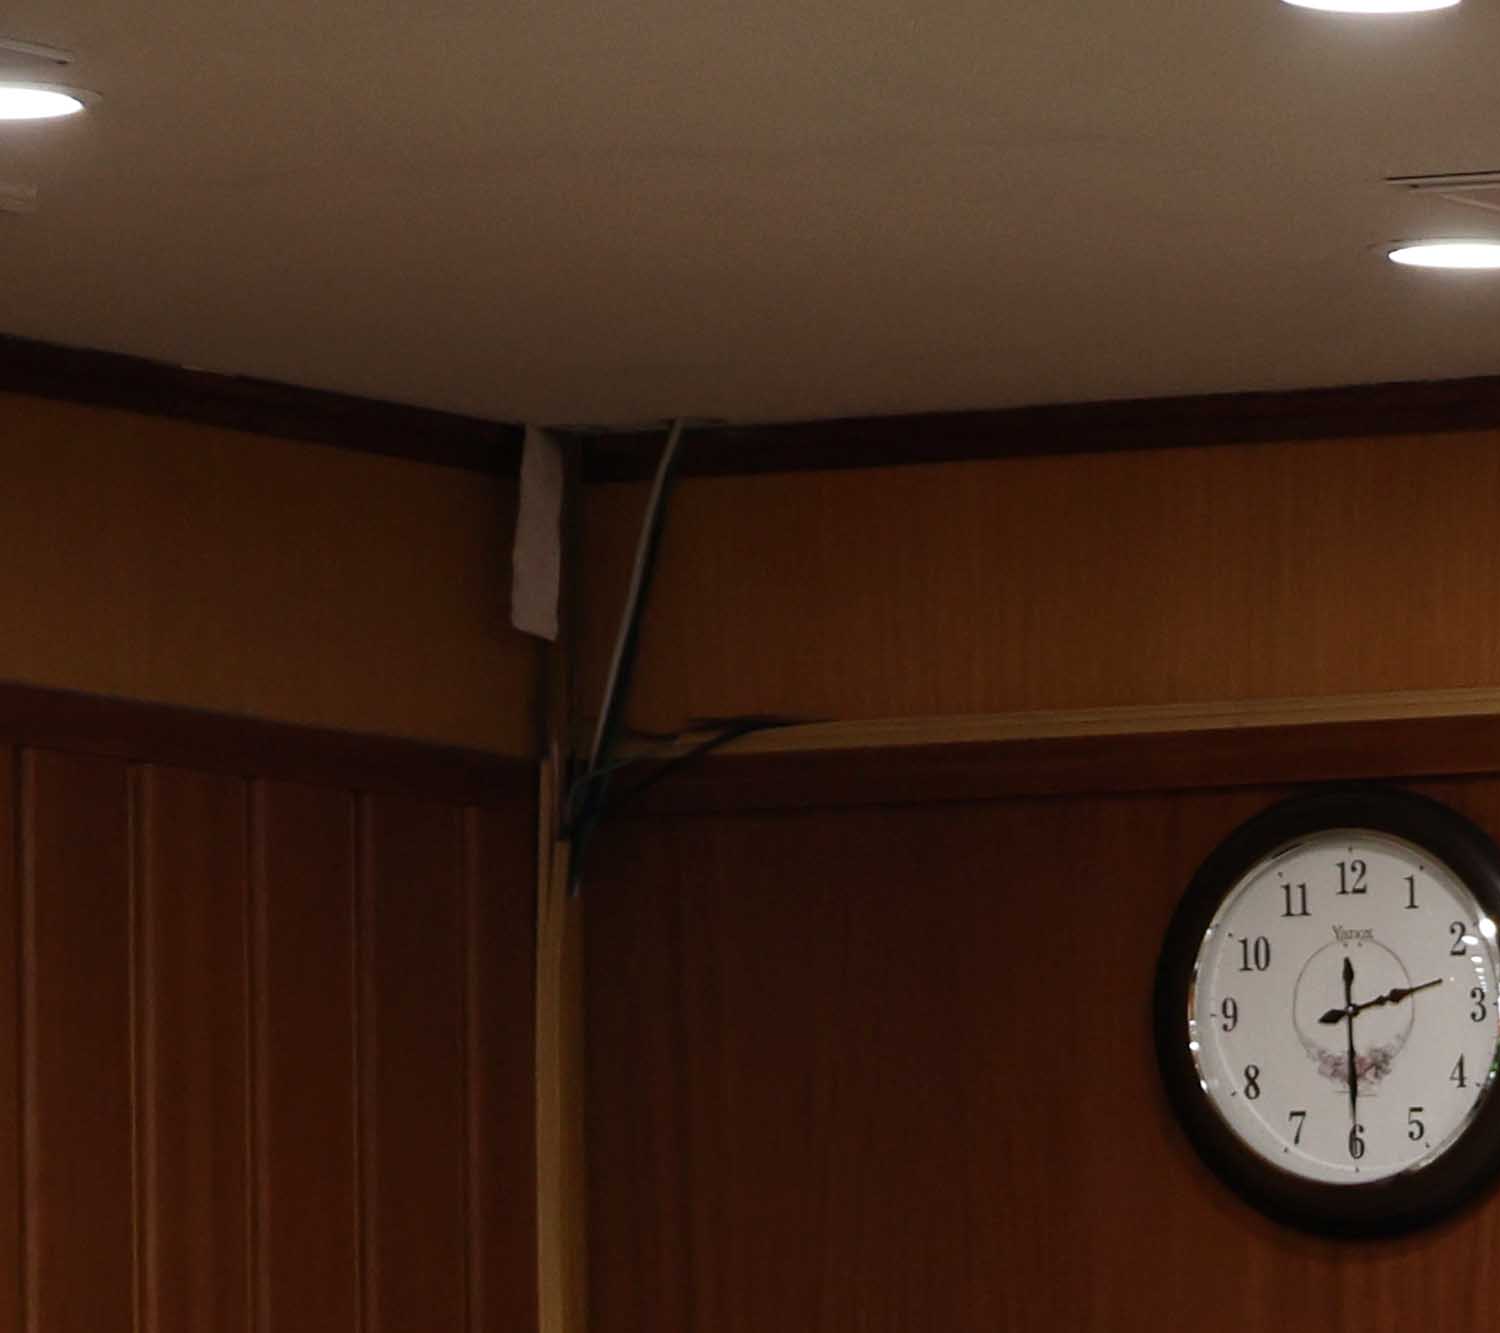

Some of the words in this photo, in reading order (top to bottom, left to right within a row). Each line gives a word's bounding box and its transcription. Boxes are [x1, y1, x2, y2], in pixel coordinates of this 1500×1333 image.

[1335, 859, 1368, 896] 12
[1403, 874, 1419, 910] 1
[1279, 882, 1313, 918] 11
[1238, 935, 1271, 972] 10
[1449, 921, 1468, 957] 2
[1221, 996, 1239, 1033] 9
[1470, 987, 1487, 1023] 3
[1243, 1064, 1261, 1101] 8
[1449, 1054, 1466, 1089] 4
[1288, 1110, 1307, 1145] 7
[1347, 1122, 1366, 1160] 6
[1407, 1106, 1425, 1142] 5
